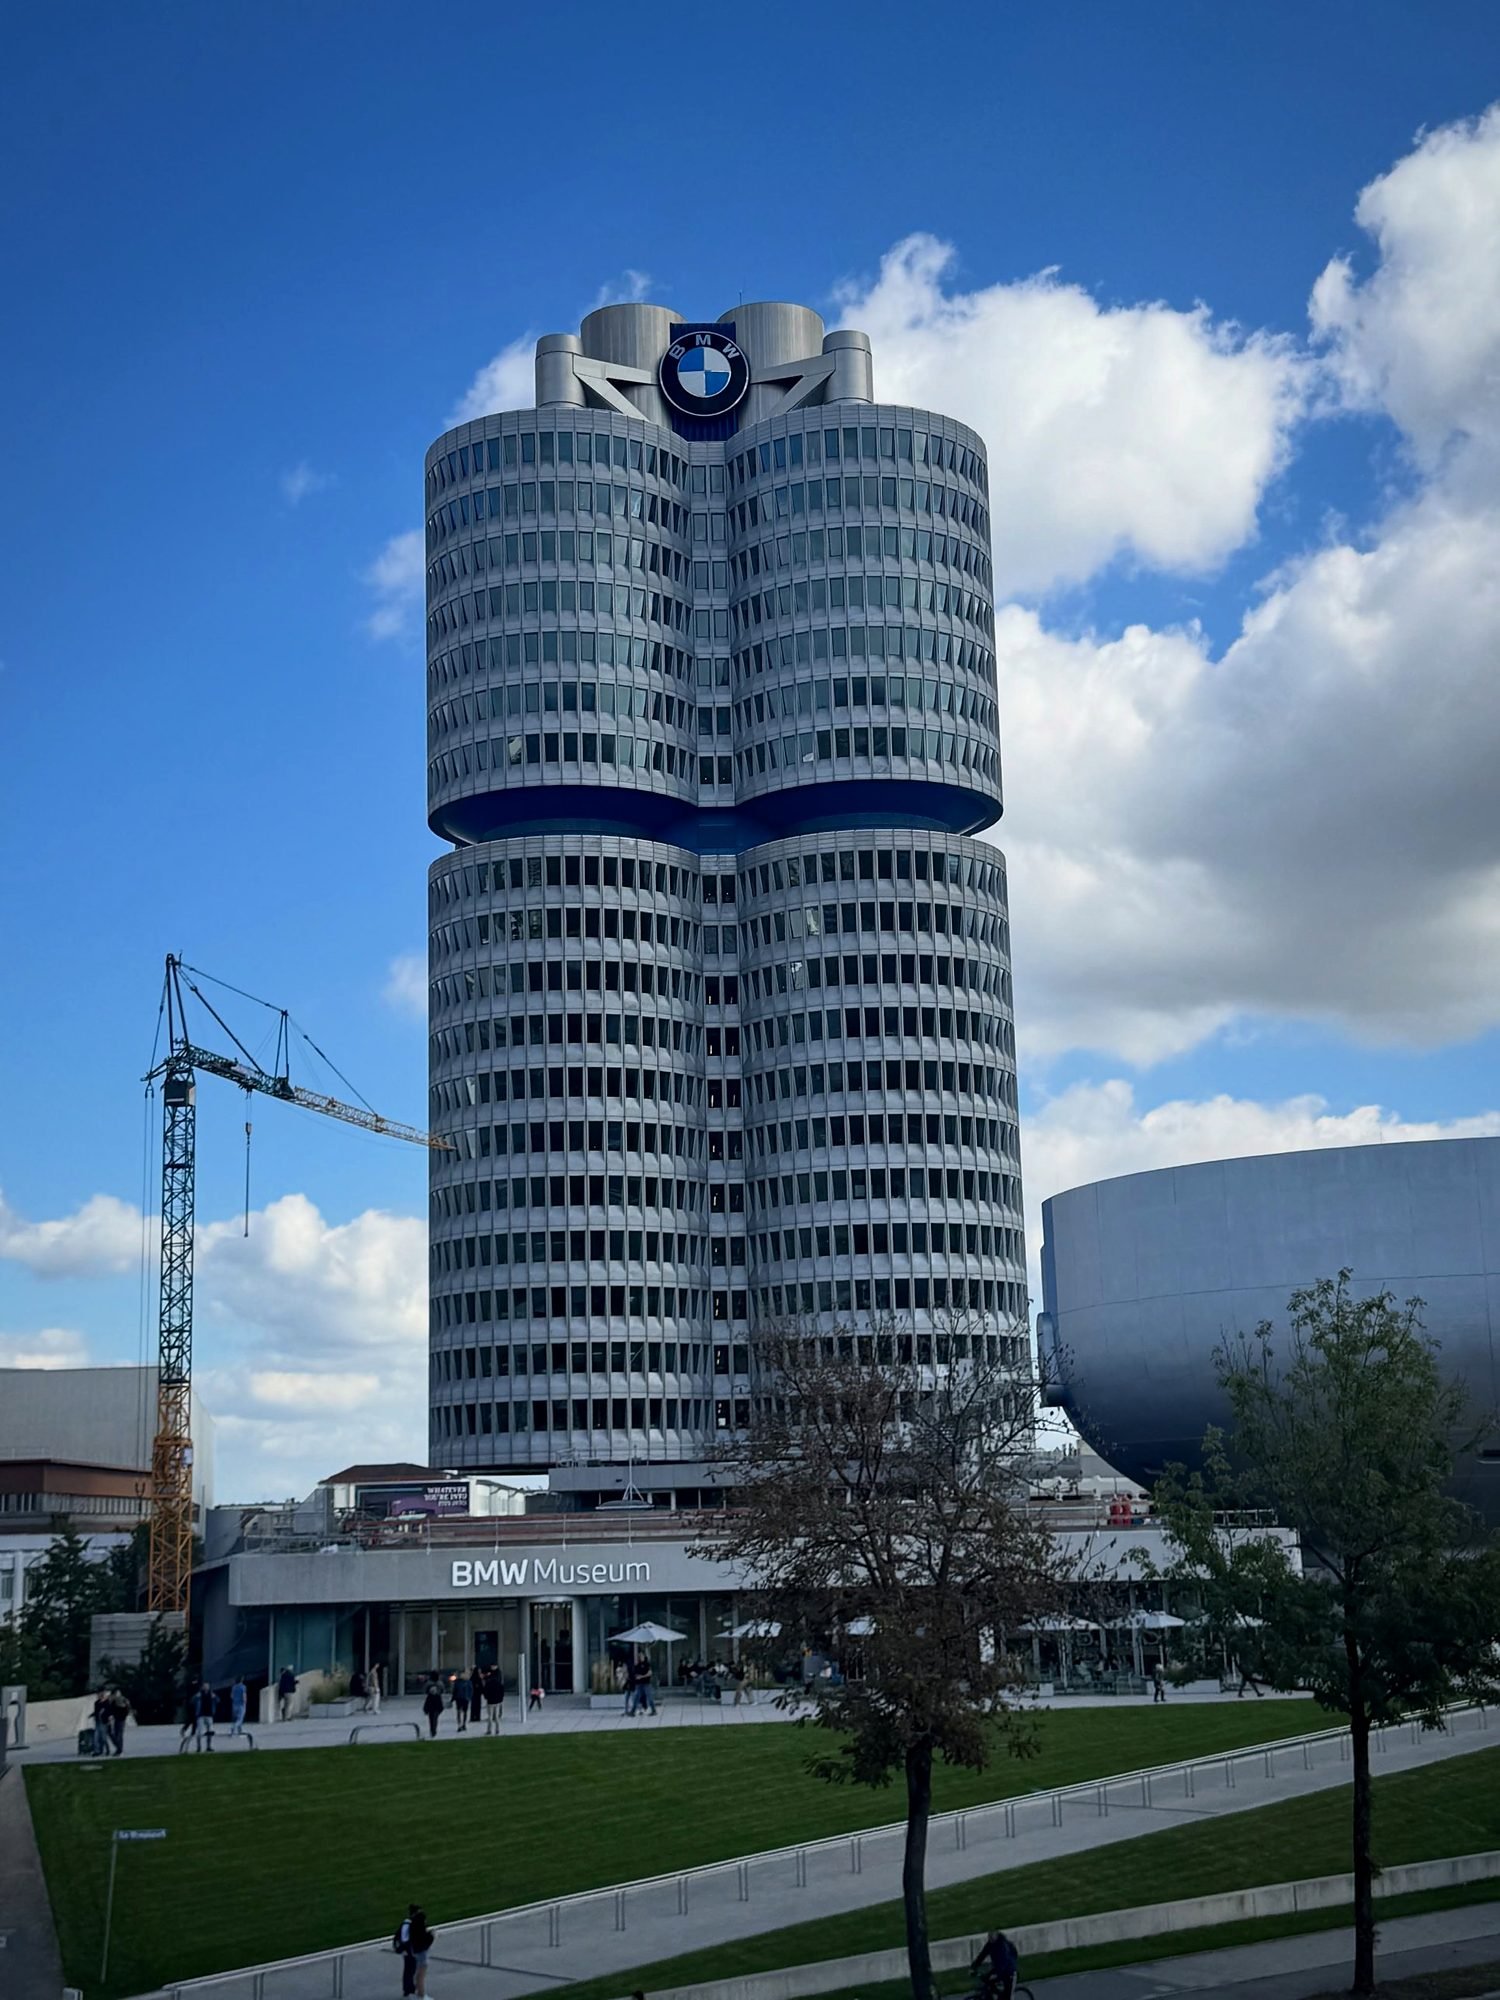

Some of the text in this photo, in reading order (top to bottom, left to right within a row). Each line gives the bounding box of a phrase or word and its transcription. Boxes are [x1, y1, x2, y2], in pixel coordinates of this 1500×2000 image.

[669, 334, 740, 360] BMW
[452, 1558, 650, 1587] BMW Museum
